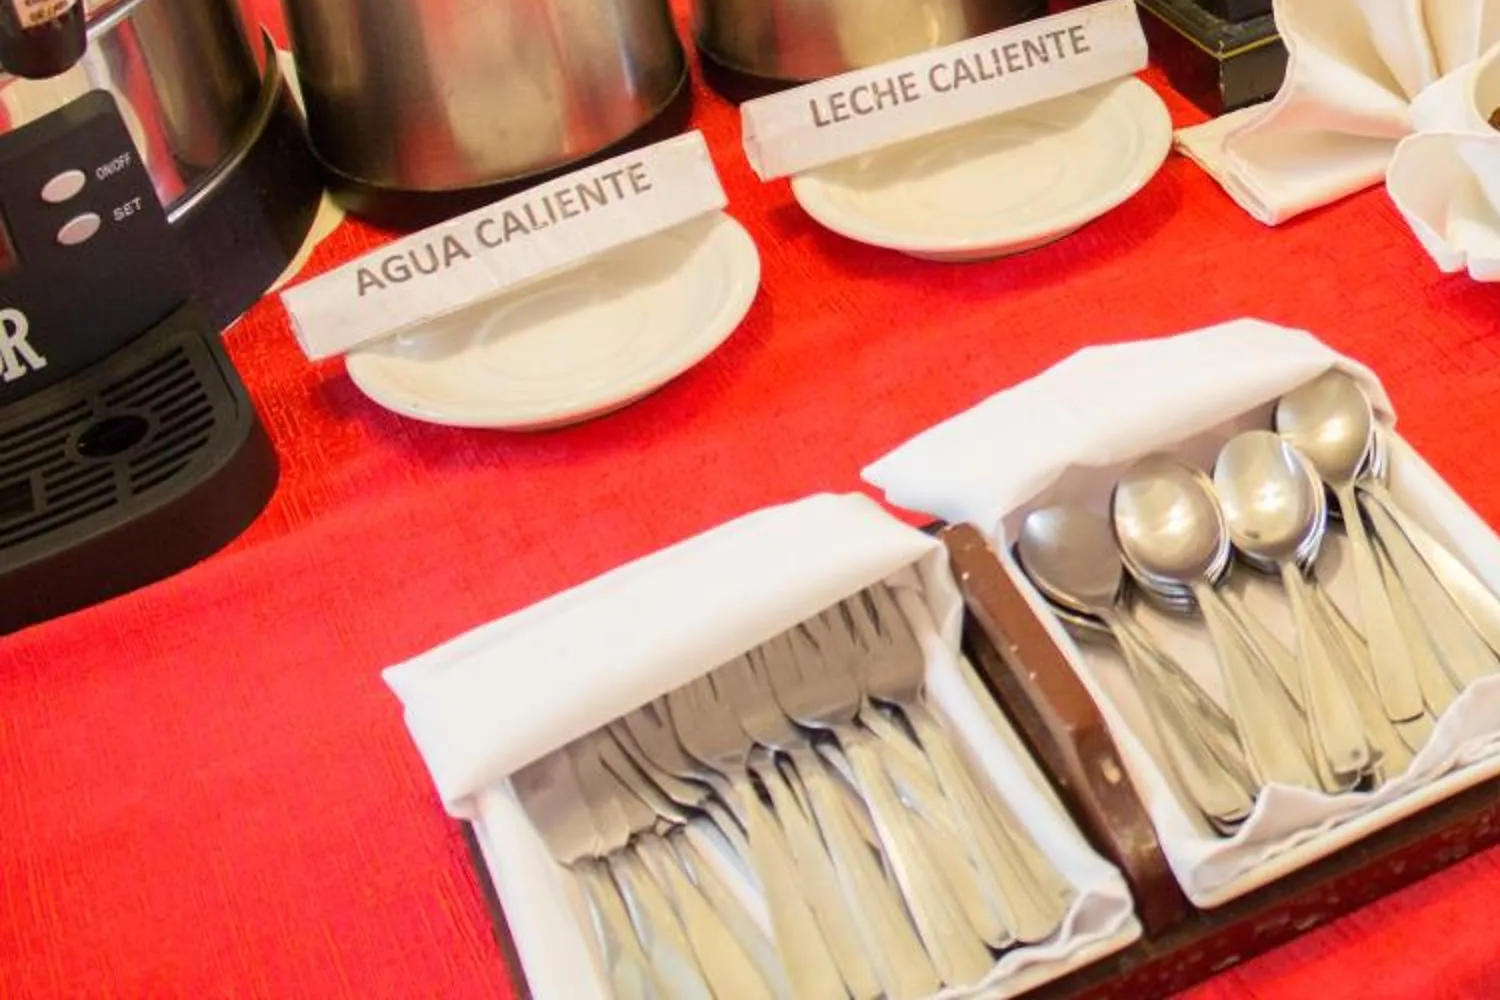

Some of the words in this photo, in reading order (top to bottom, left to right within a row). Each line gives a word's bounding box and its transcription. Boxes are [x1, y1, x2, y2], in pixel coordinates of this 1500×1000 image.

[809, 72, 921, 128] LECHE
[927, 25, 1092, 93] CALIENTE
[95, 152, 132, 181] ON/OFF
[112, 196, 142, 222] SET
[355, 233, 472, 297] AGUA
[475, 161, 654, 249] CALIENTE
